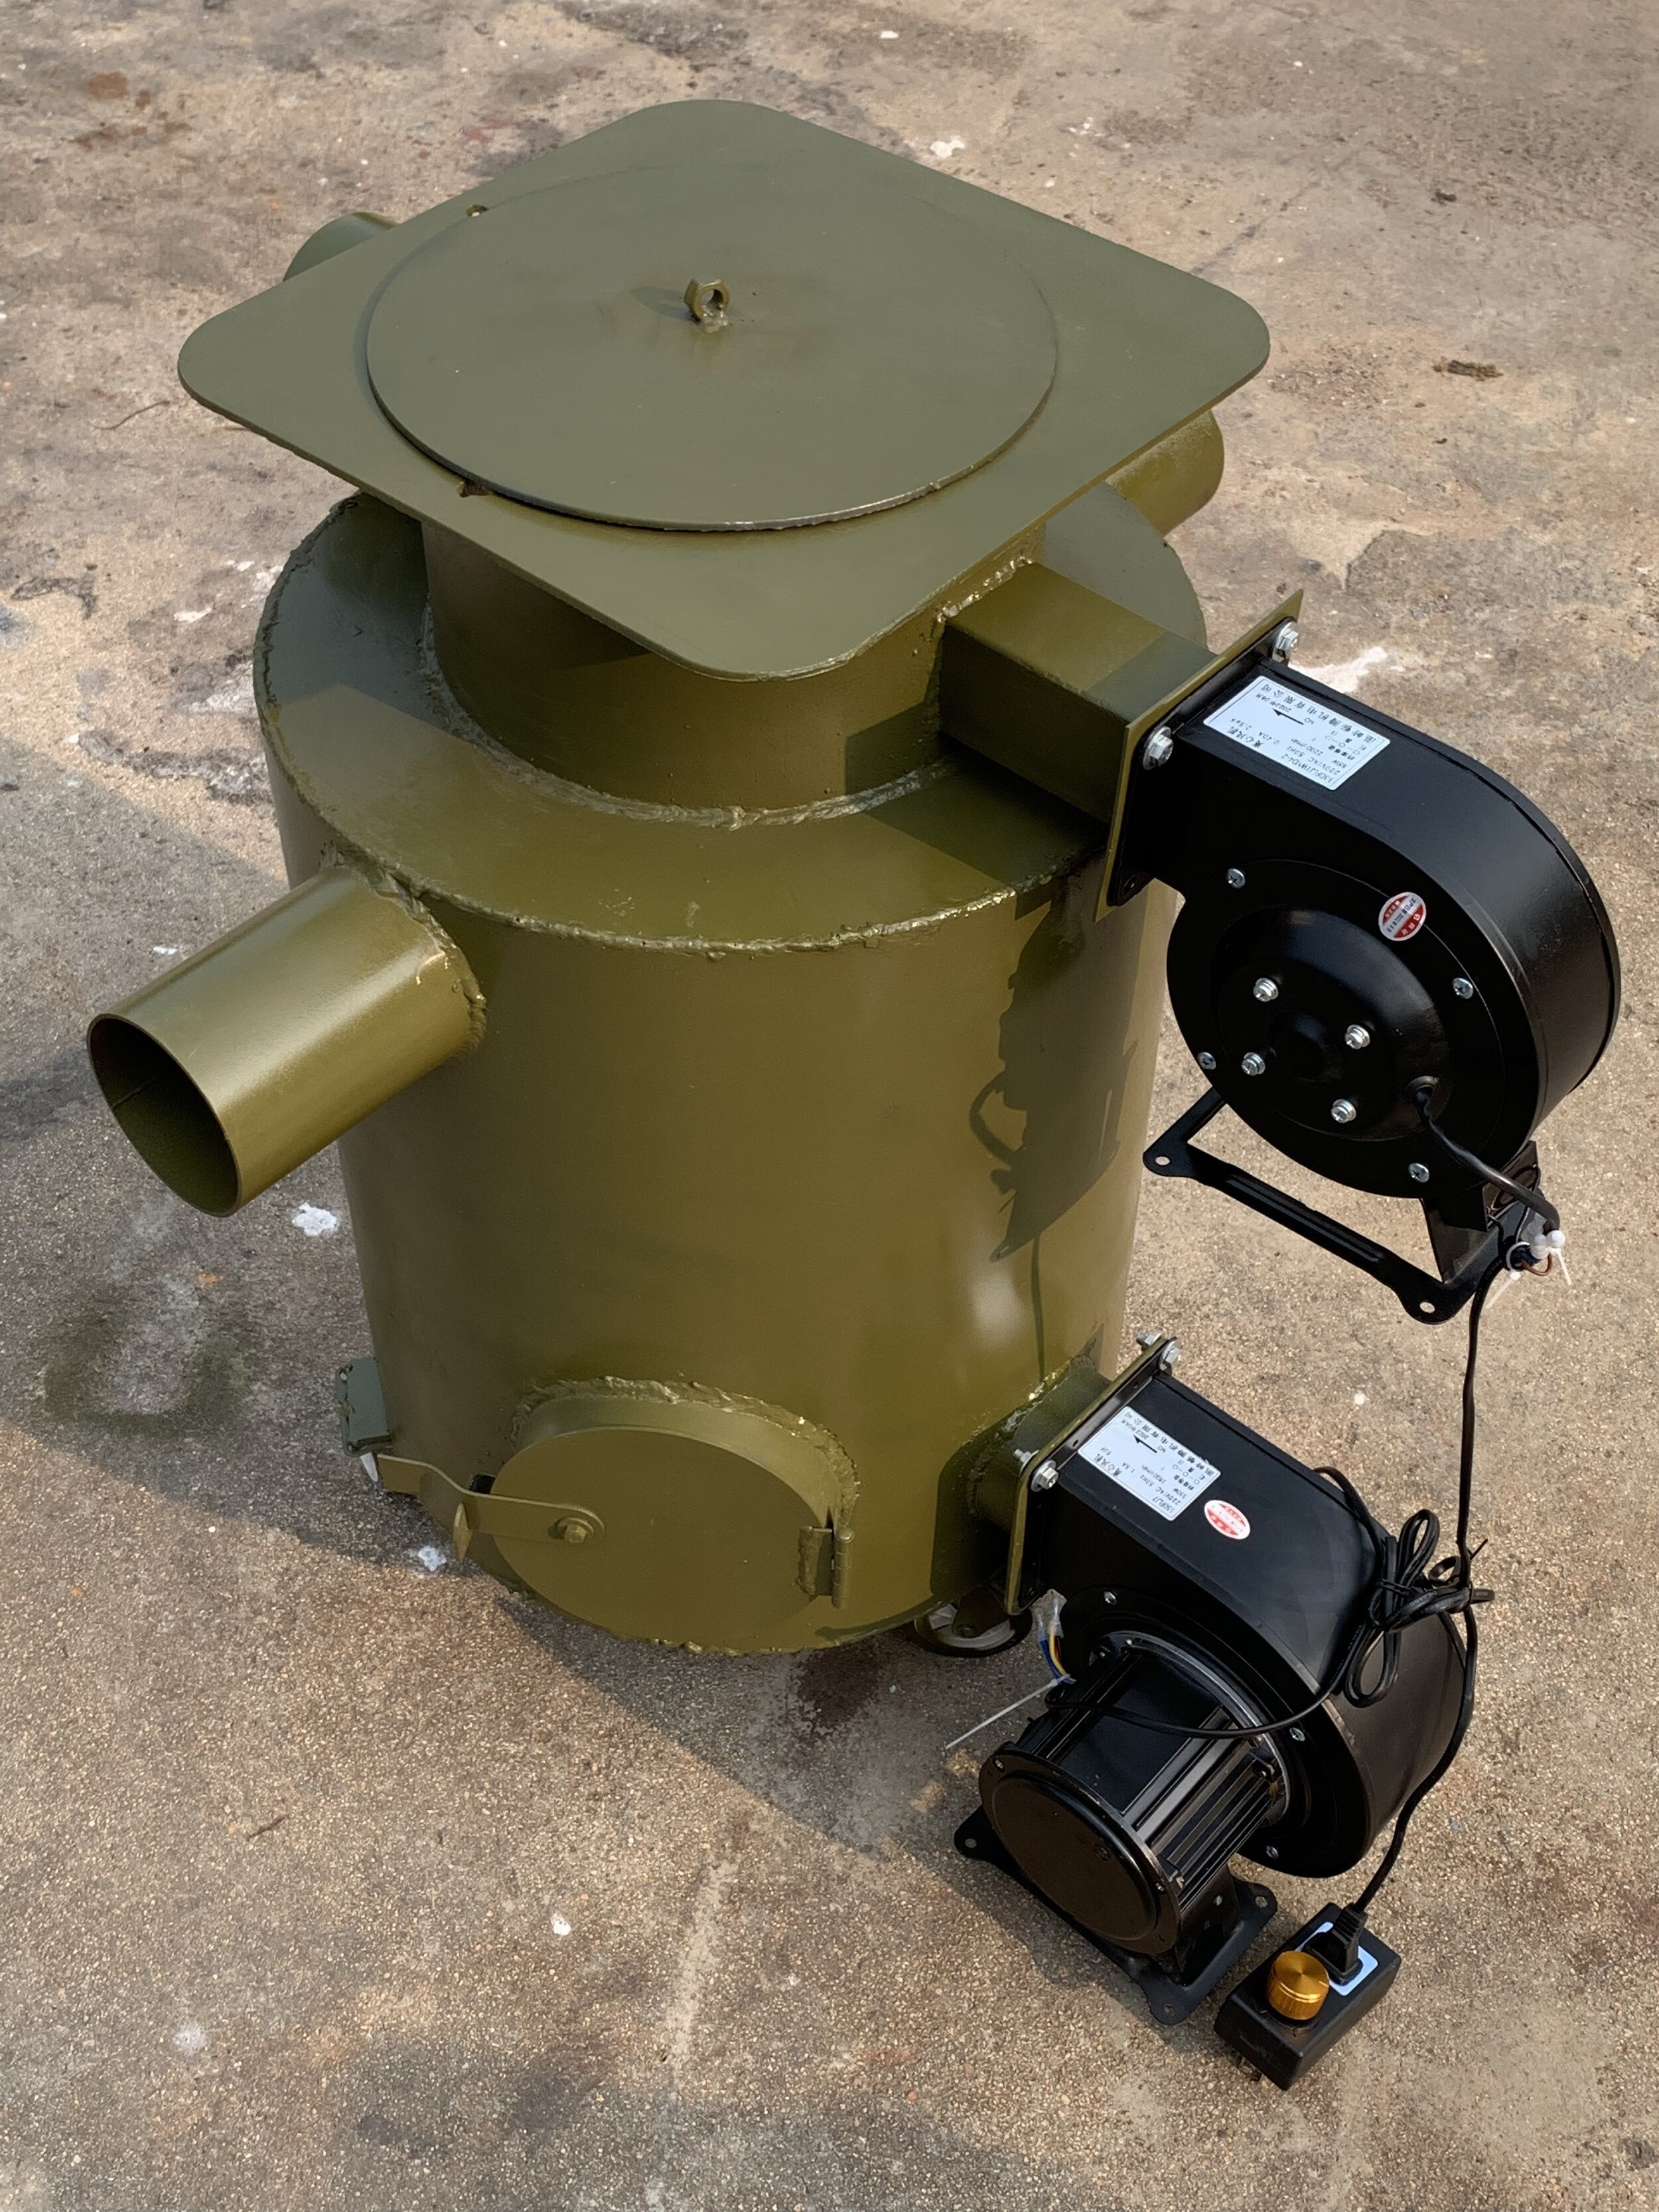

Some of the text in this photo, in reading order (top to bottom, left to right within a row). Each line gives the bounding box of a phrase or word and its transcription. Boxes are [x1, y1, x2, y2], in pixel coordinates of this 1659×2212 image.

[1226, 725, 1264, 749] 离心风机
[1093, 1452, 1122, 1477] 离心风机
